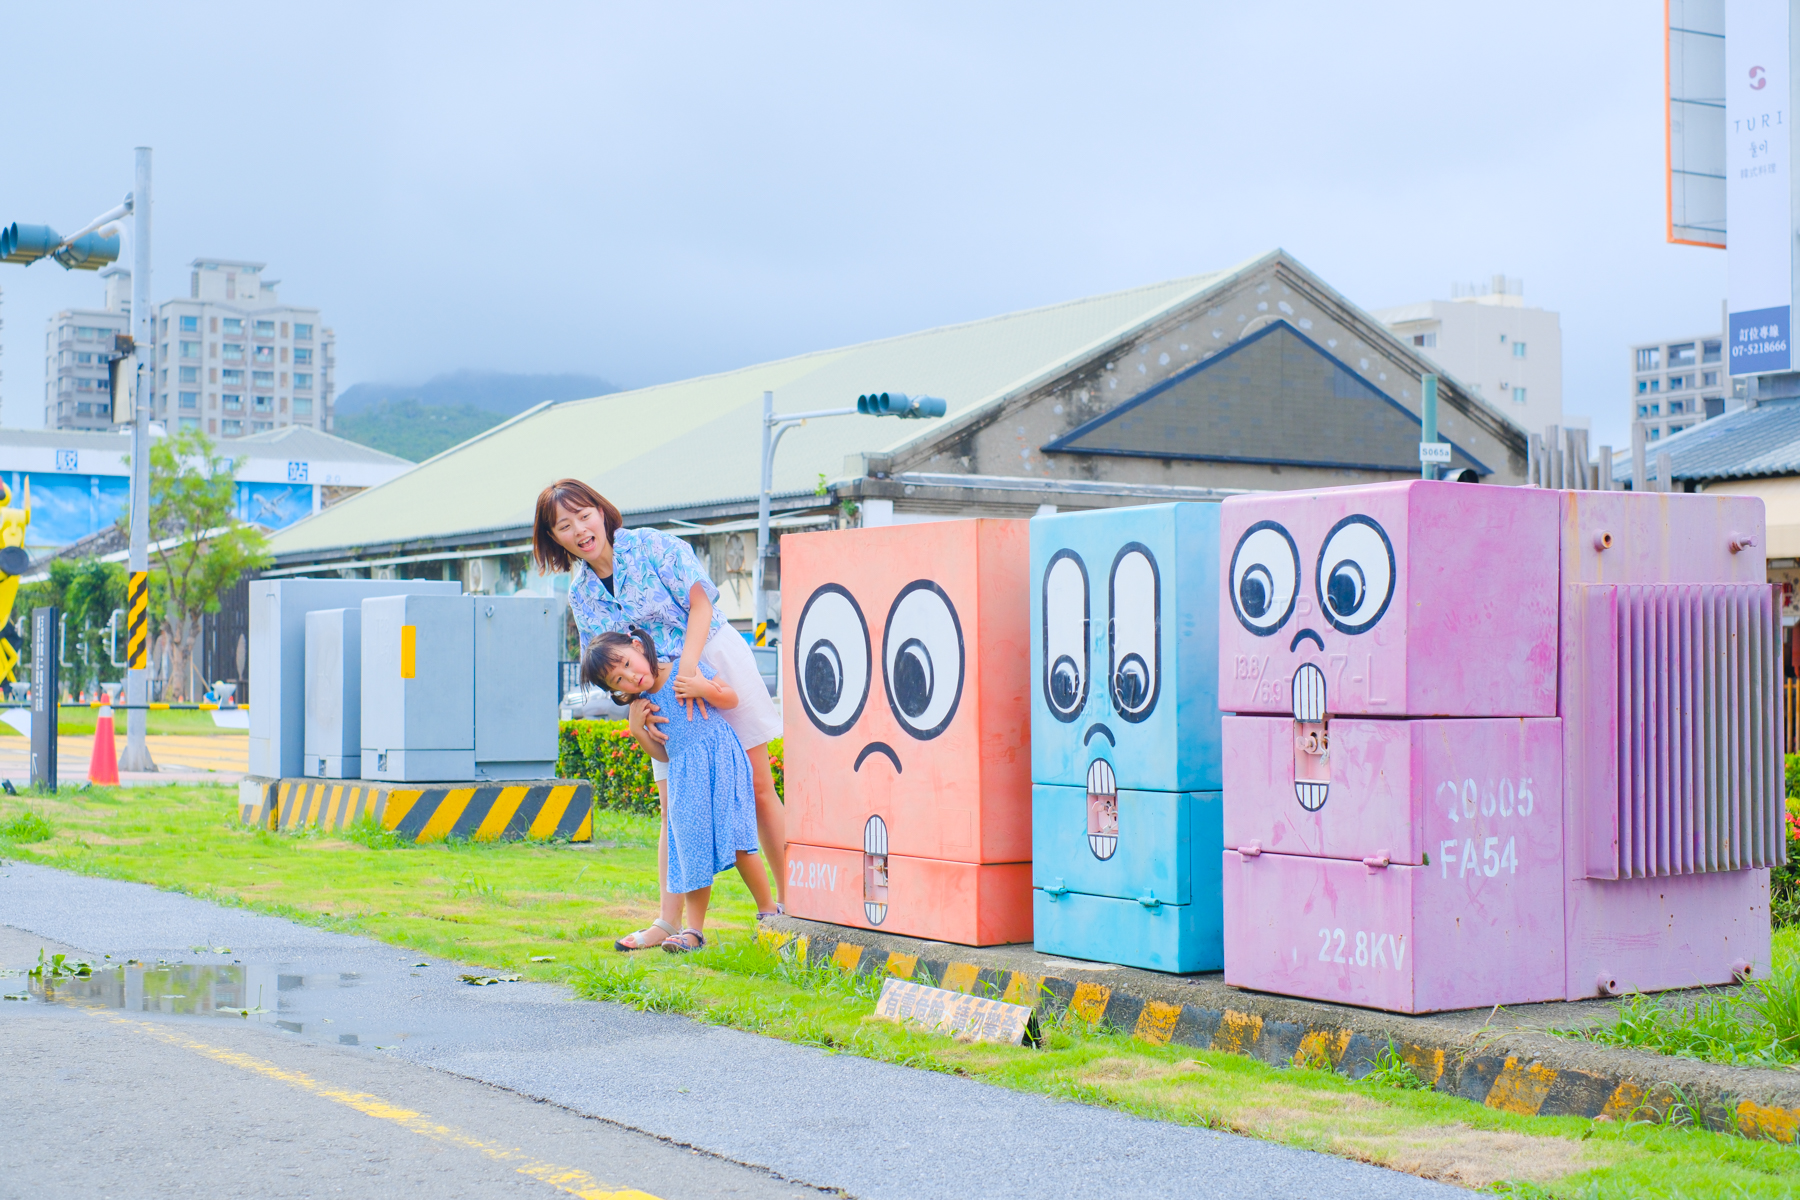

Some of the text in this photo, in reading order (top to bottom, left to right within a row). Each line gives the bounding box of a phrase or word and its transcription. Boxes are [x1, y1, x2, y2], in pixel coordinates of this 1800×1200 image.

[1734, 110, 1782, 134] TURI
[1740, 163, 1776, 179] 韓式料理
[1739, 324, 1779, 342] 訂位專線
[1732, 339, 1787, 357] 07-5218666
[1422, 448, 1450, 457] S065a
[287, 461, 308, 482] 站
[1437, 777, 1534, 822] Q0605
[1440, 835, 1519, 879] FA54
[788, 859, 838, 892] 22.8KV
[1318, 927, 1408, 972] 22.8KV
